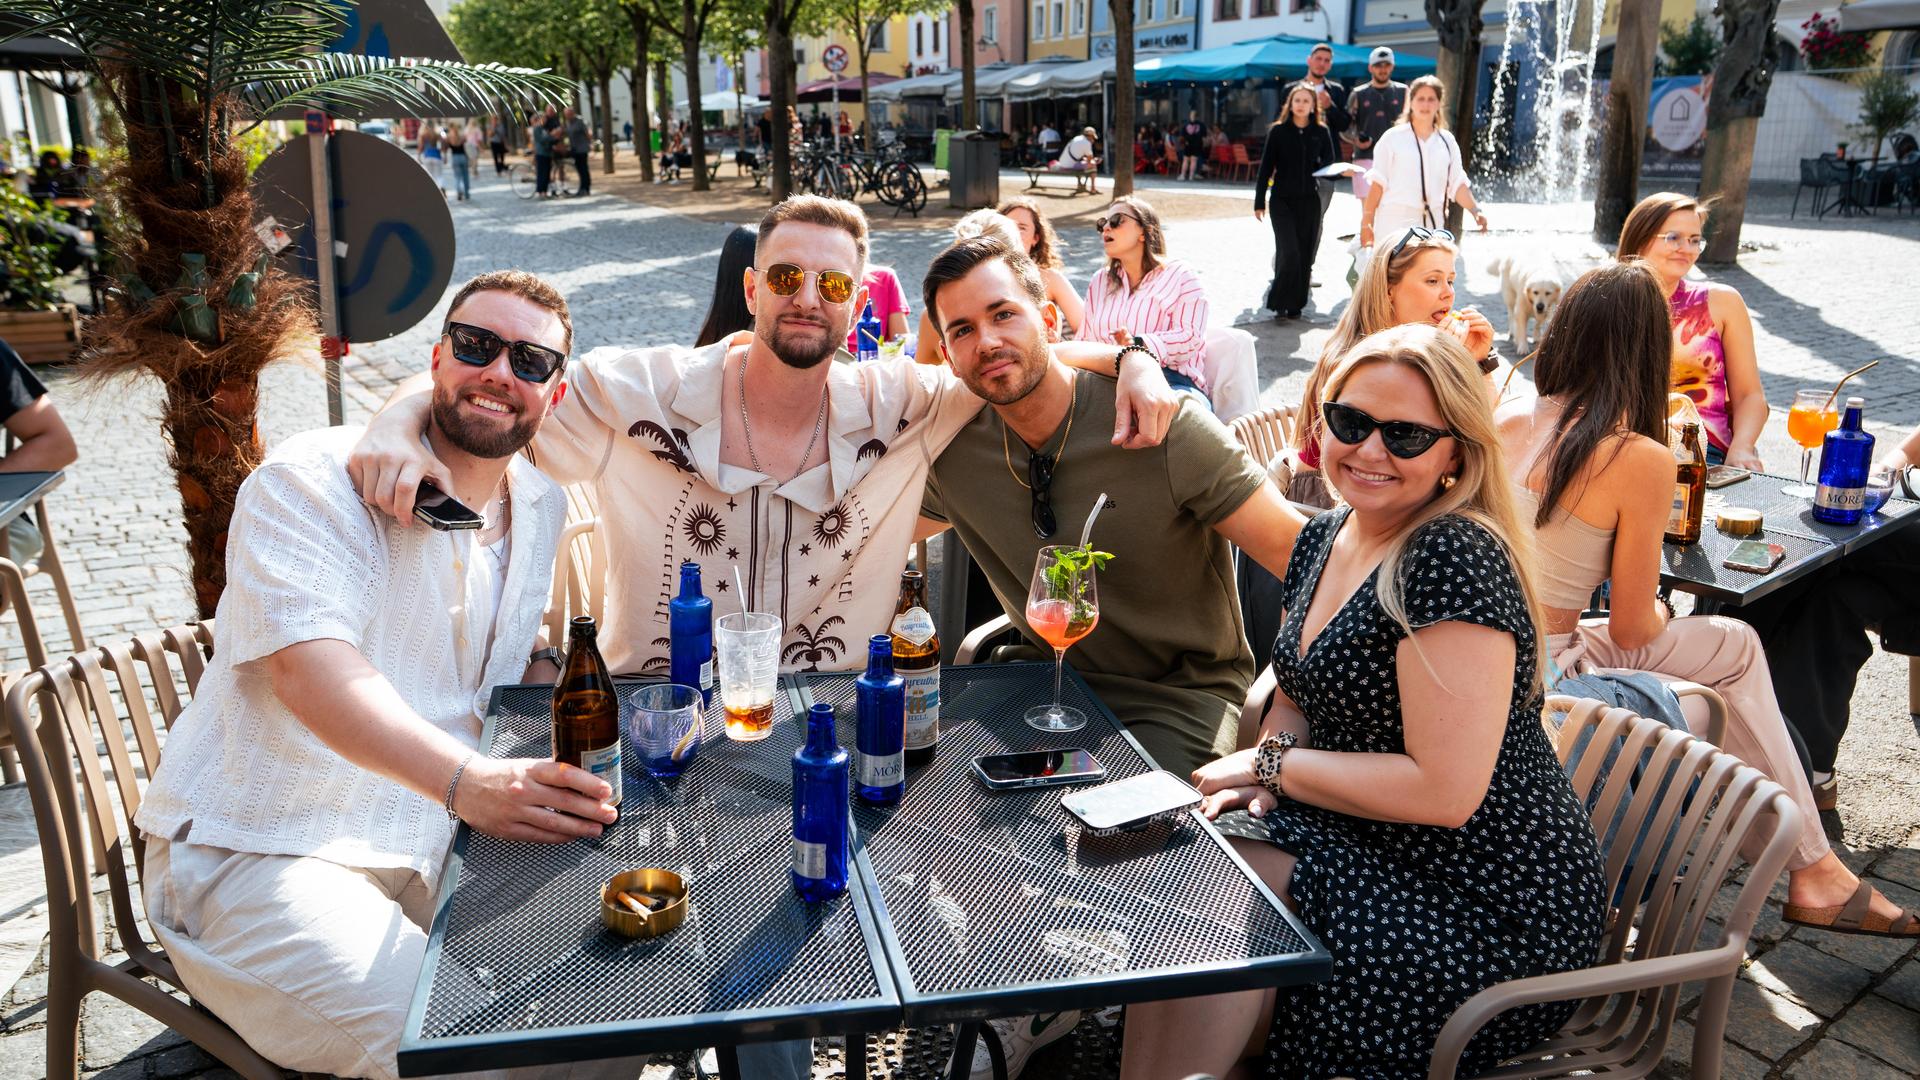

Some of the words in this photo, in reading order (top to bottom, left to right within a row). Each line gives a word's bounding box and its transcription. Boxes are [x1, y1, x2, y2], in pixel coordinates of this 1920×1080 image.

[1094, 500, 1116, 509] SS
[1826, 493, 1864, 505] MORE
[873, 764, 902, 776] MOR
